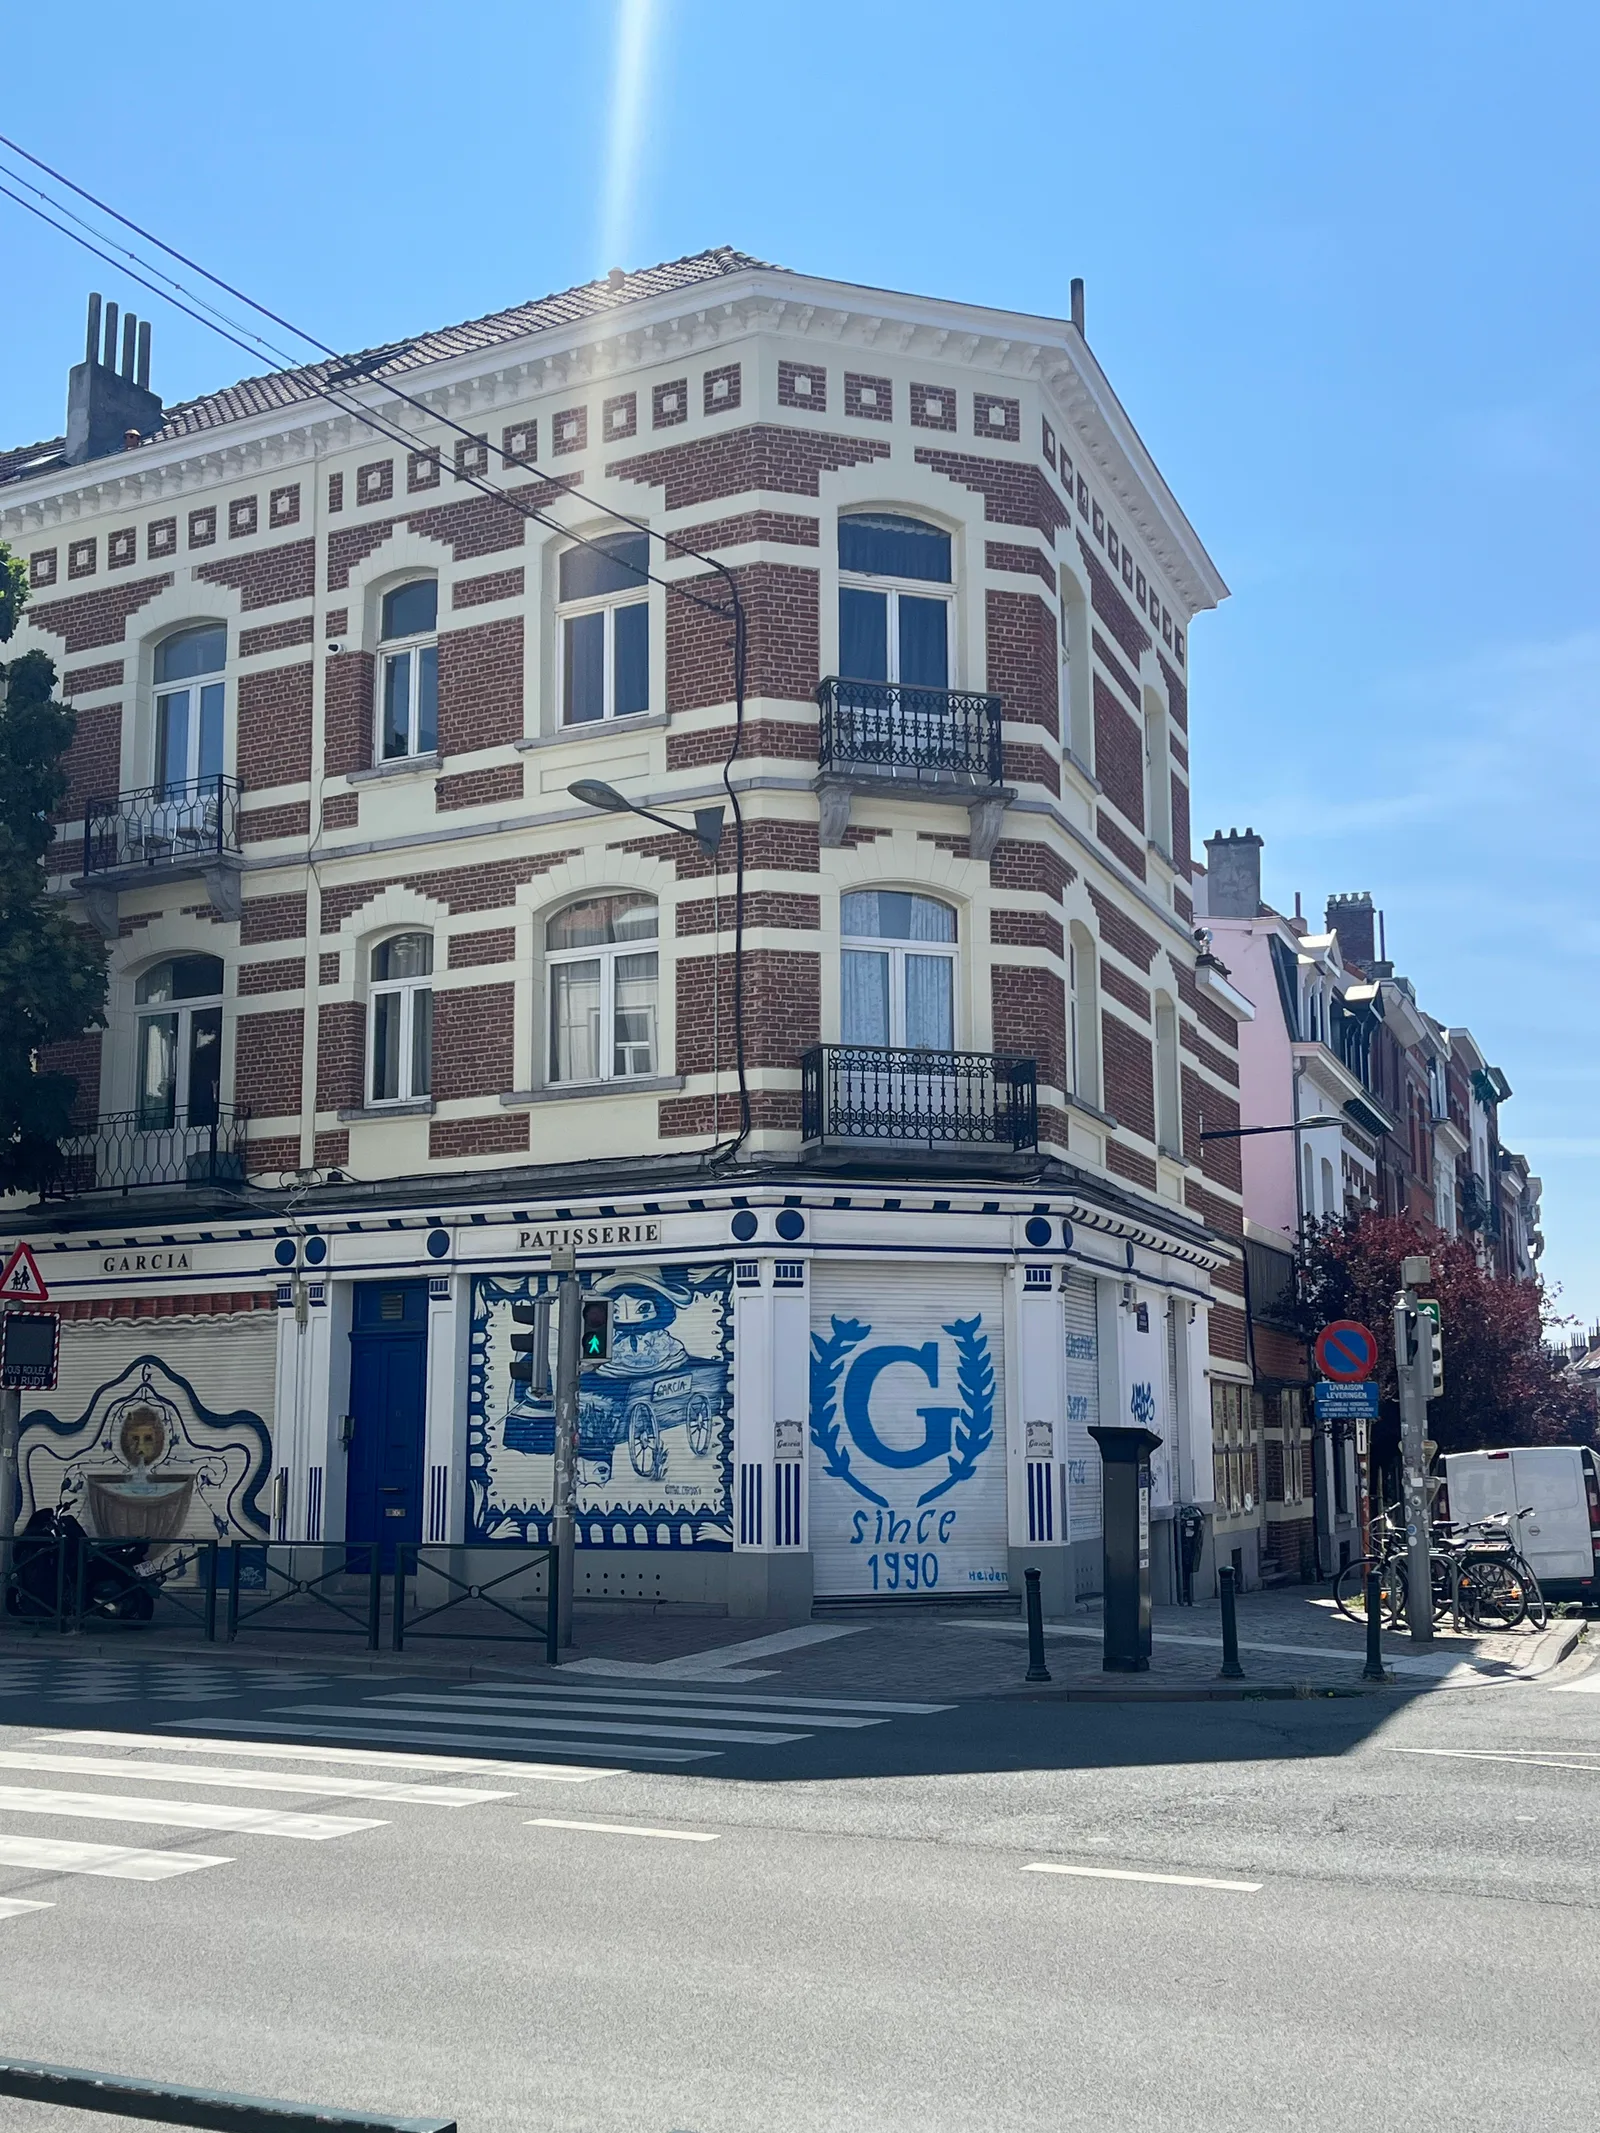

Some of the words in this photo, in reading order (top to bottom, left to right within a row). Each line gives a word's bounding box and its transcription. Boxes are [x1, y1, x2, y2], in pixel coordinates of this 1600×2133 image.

[519, 1224, 658, 1247] PATISSERIE
[103, 1253, 188, 1272] GARCIA
[5, 1365, 21, 1375] VOUS
[22, 1366, 47, 1376] ROULEZ
[10, 1376, 17, 1385] U
[21, 1376, 46, 1386] RIJDT
[843, 1342, 960, 1469] G
[867, 1552, 939, 1591] 1990
